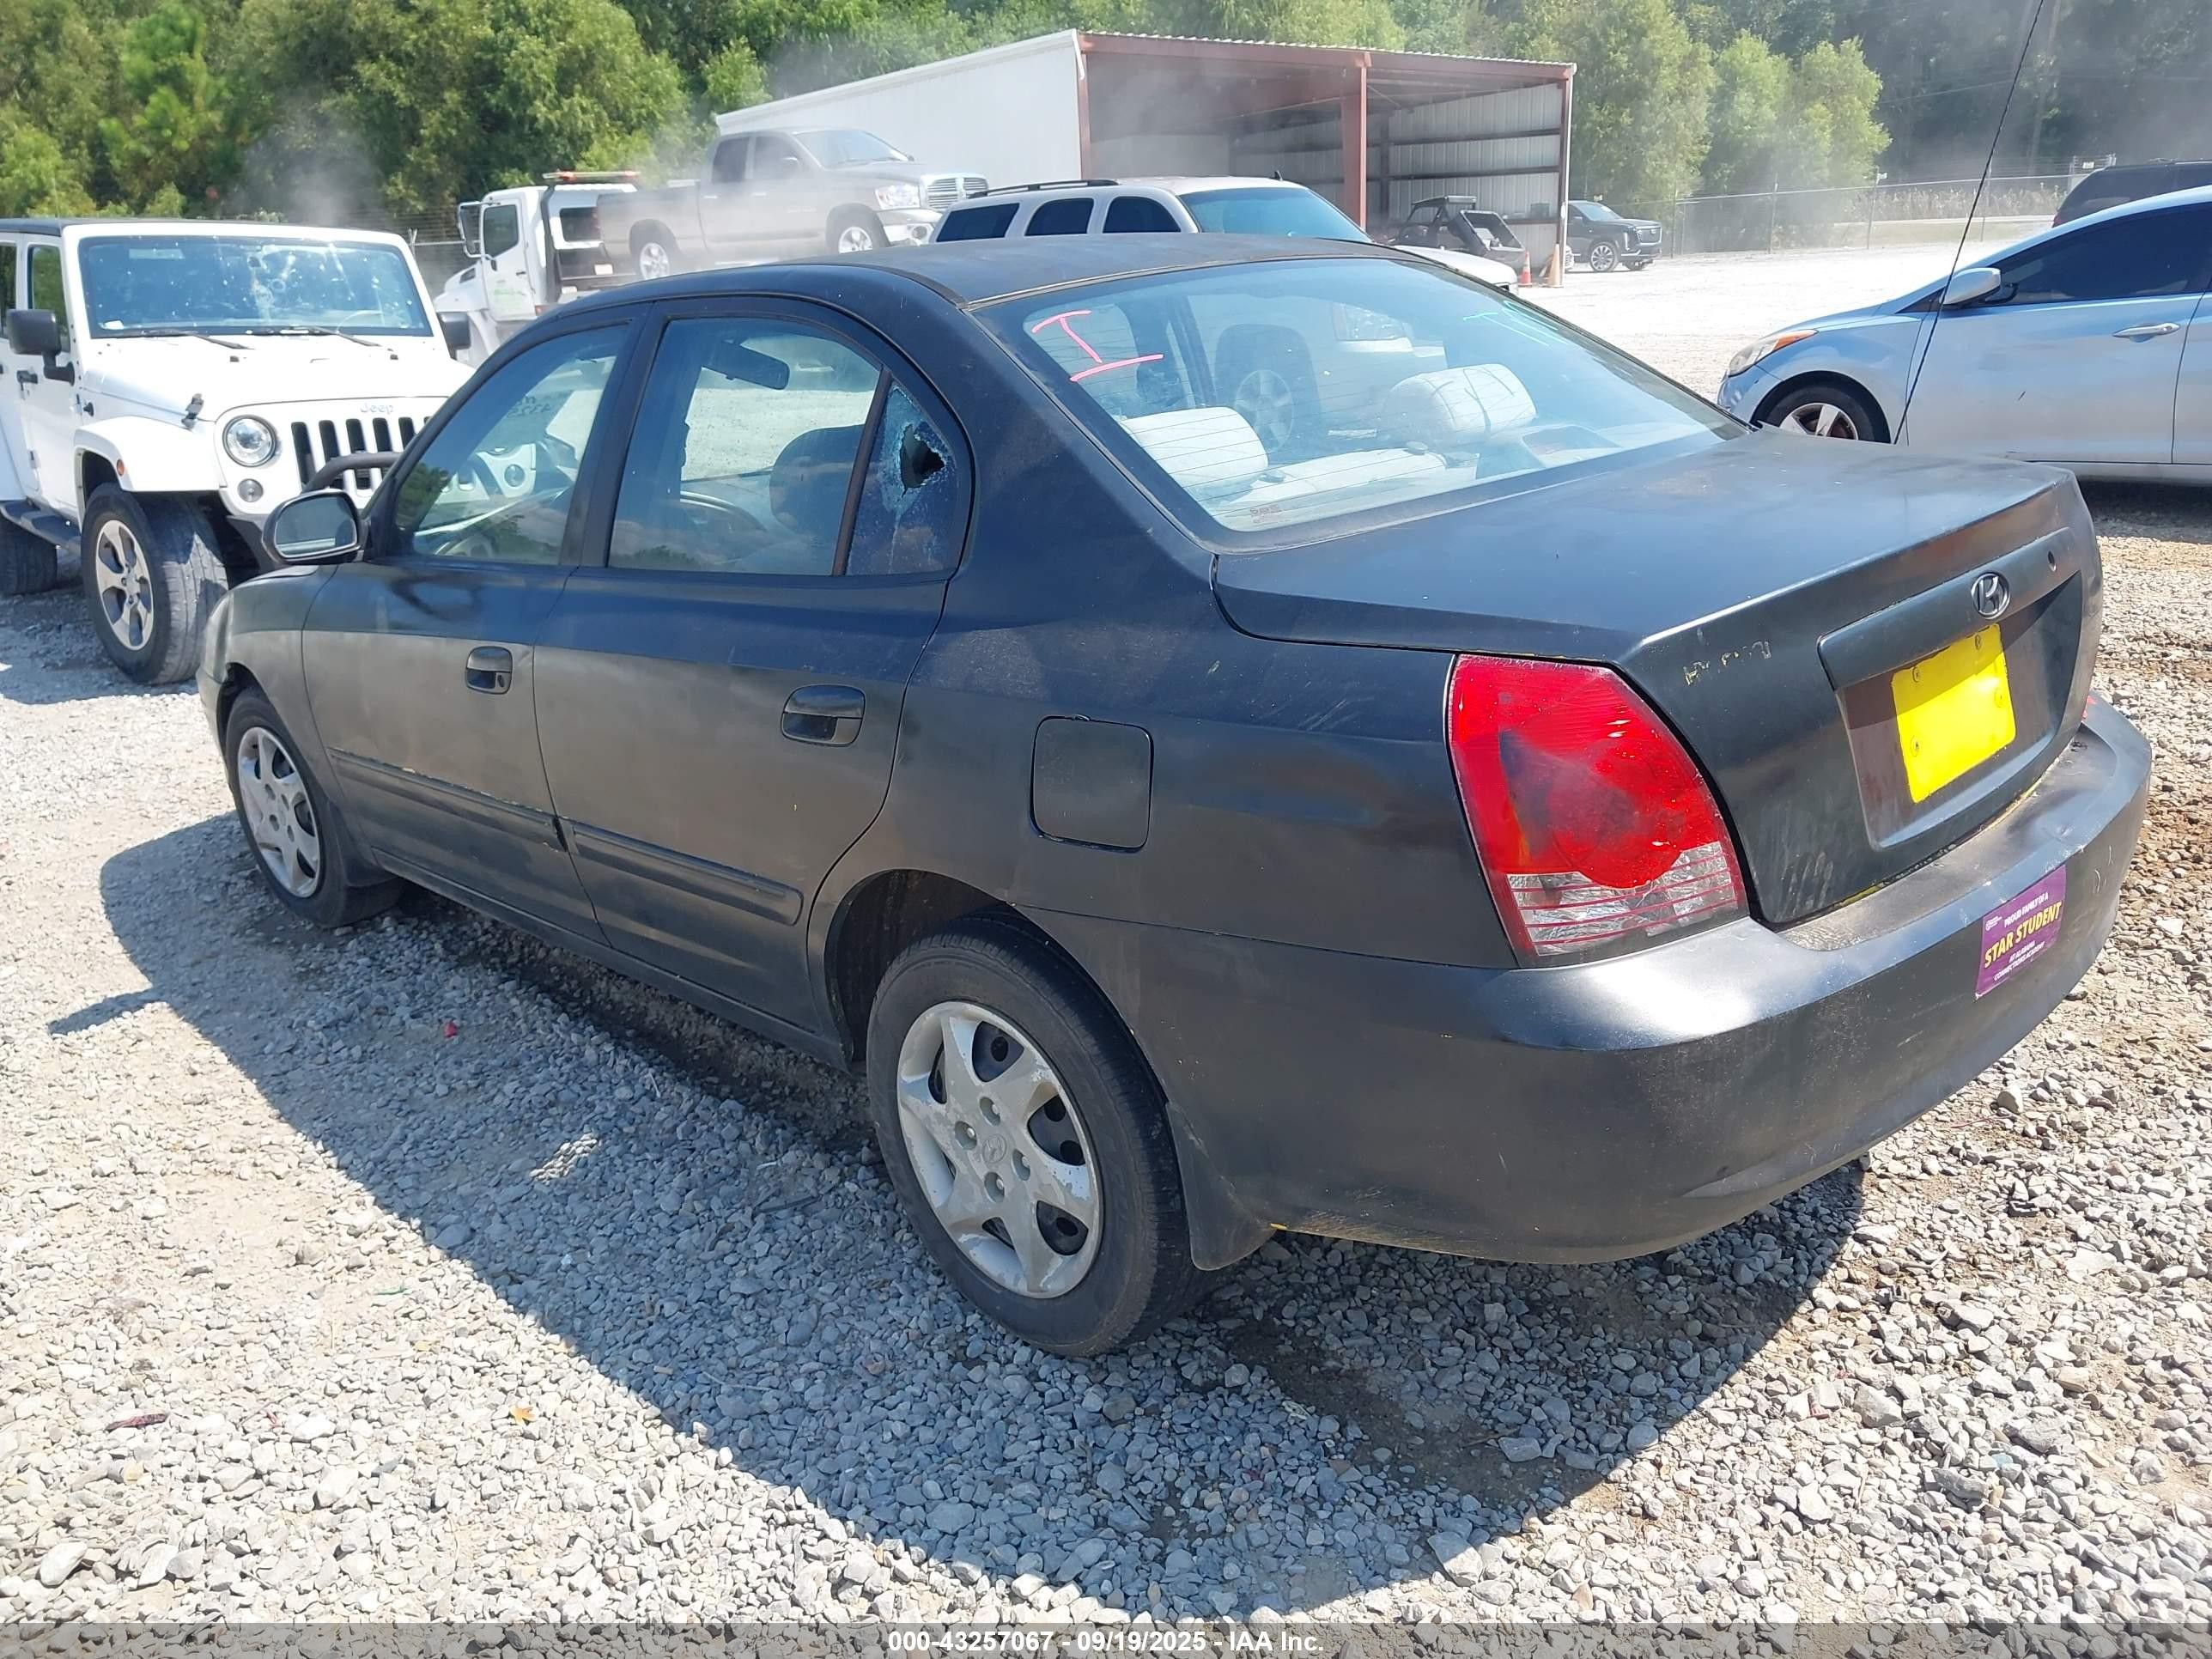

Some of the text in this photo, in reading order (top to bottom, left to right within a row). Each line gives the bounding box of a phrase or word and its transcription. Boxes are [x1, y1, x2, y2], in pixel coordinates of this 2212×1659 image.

[360, 402, 394, 416] Jeep
[2003, 908, 2022, 928] PROUD
[1984, 901, 2063, 969] STAR STUDENT
